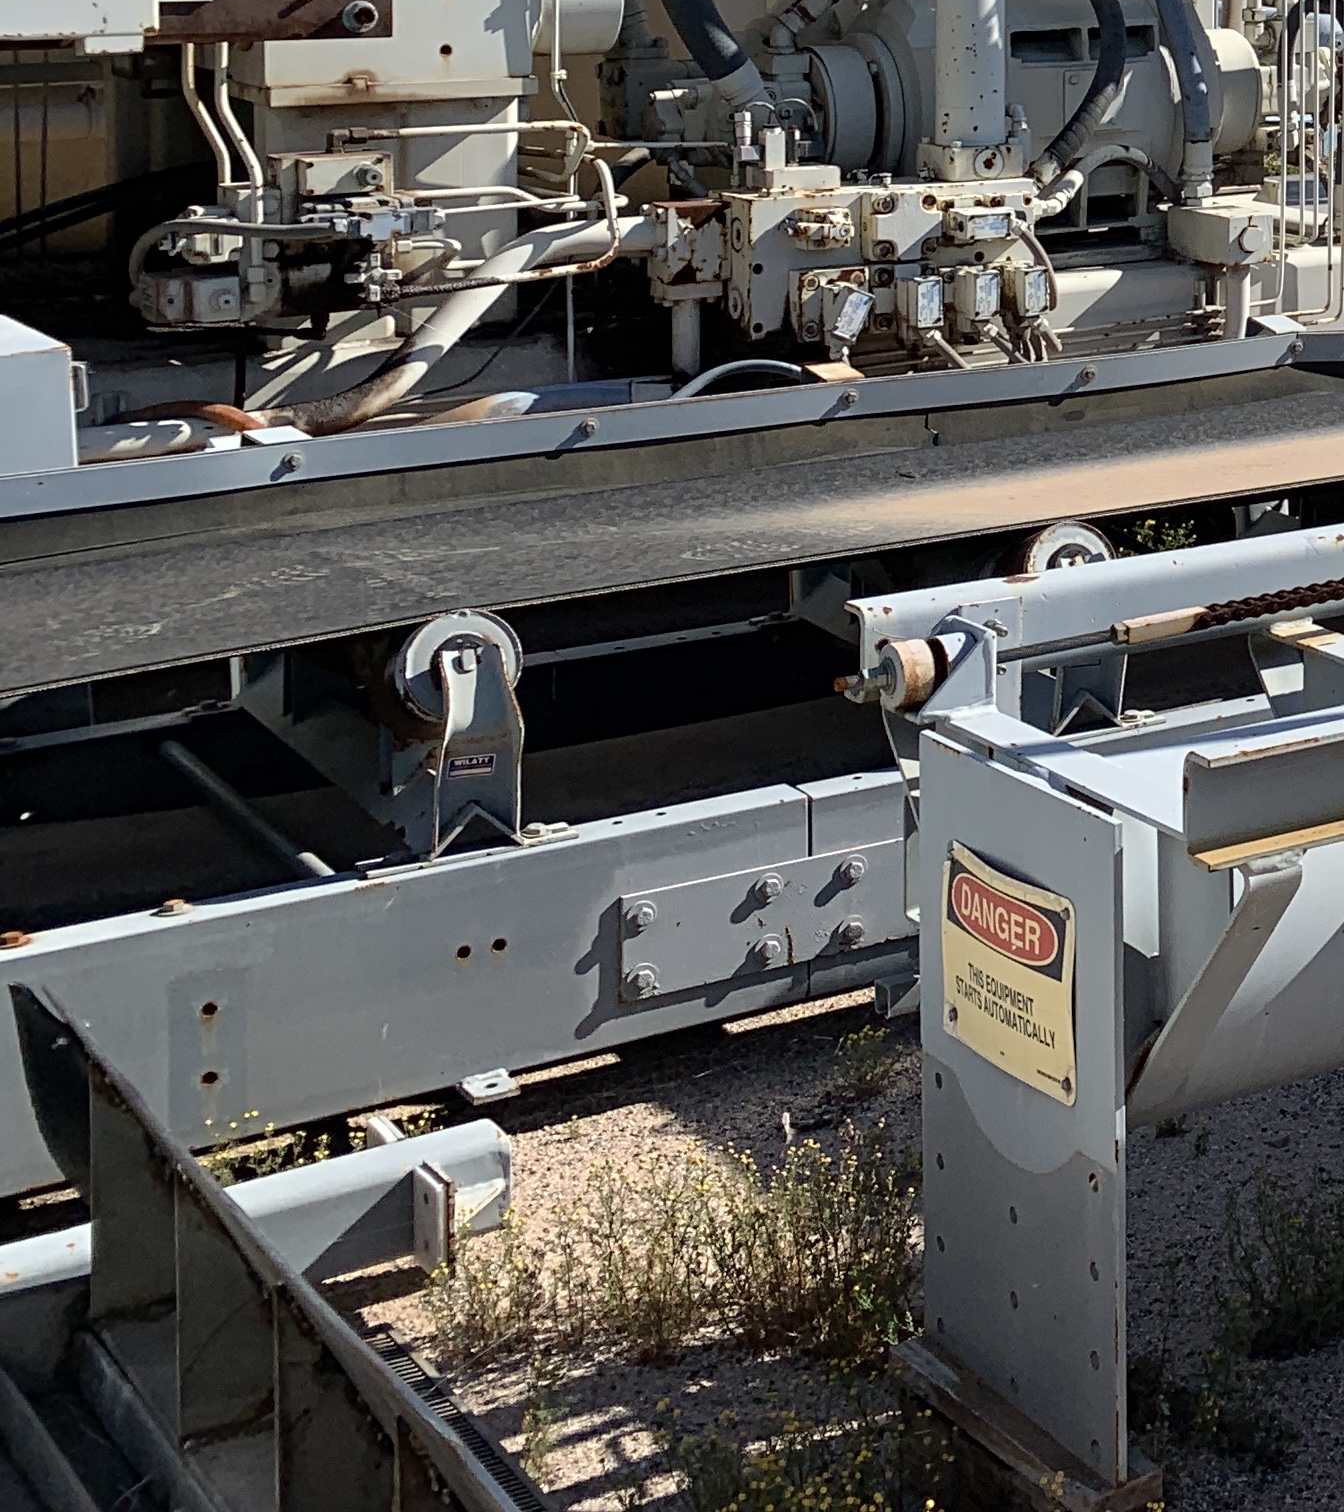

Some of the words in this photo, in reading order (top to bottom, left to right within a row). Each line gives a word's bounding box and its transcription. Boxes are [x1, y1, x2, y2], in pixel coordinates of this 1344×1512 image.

[961, 882, 1041, 956] DANGER
[955, 975, 982, 1010] STARTS
[983, 995, 1055, 1049] AUTOMATICALLY
[968, 962, 984, 989] THIS
[985, 974, 1034, 1016] EQUIPMENT
